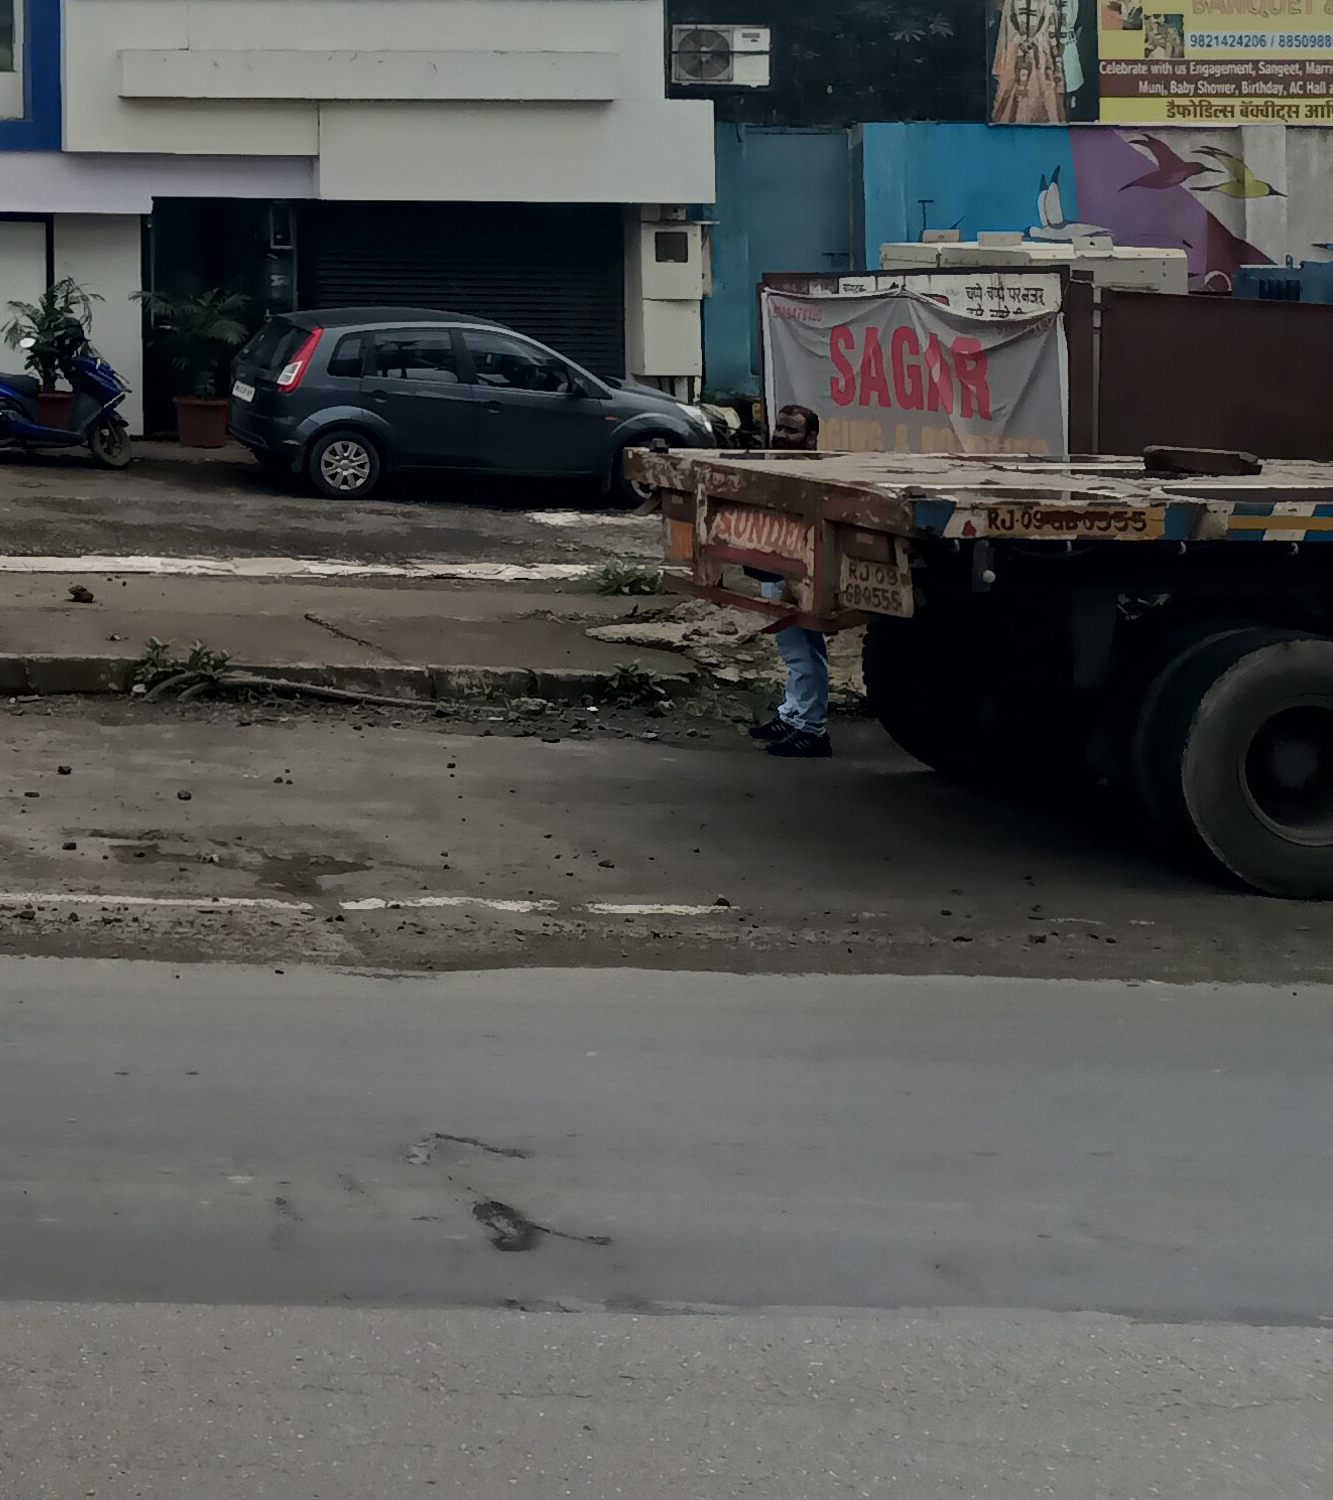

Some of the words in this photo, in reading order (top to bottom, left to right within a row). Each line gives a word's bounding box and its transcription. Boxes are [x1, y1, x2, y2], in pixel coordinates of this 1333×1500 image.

[1190, 34, 1267, 48] 9821424206
[1099, 61, 1148, 74] Celebrate
[1150, 61, 1173, 74] with
[1174, 64, 1187, 74] us
[1190, 61, 1256, 77] Engagement,
[1258, 61, 1302, 77] Sangeet,
[1139, 81, 1168, 95] Munj,
[1170, 81, 1195, 96] Baby
[1197, 80, 1238, 95] Shower,
[1241, 80, 1287, 96] Birthday,
[1289, 81, 1303, 94] AC
[1306, 81, 1326, 94] Hall
[829, 325, 991, 420] SAGAR
